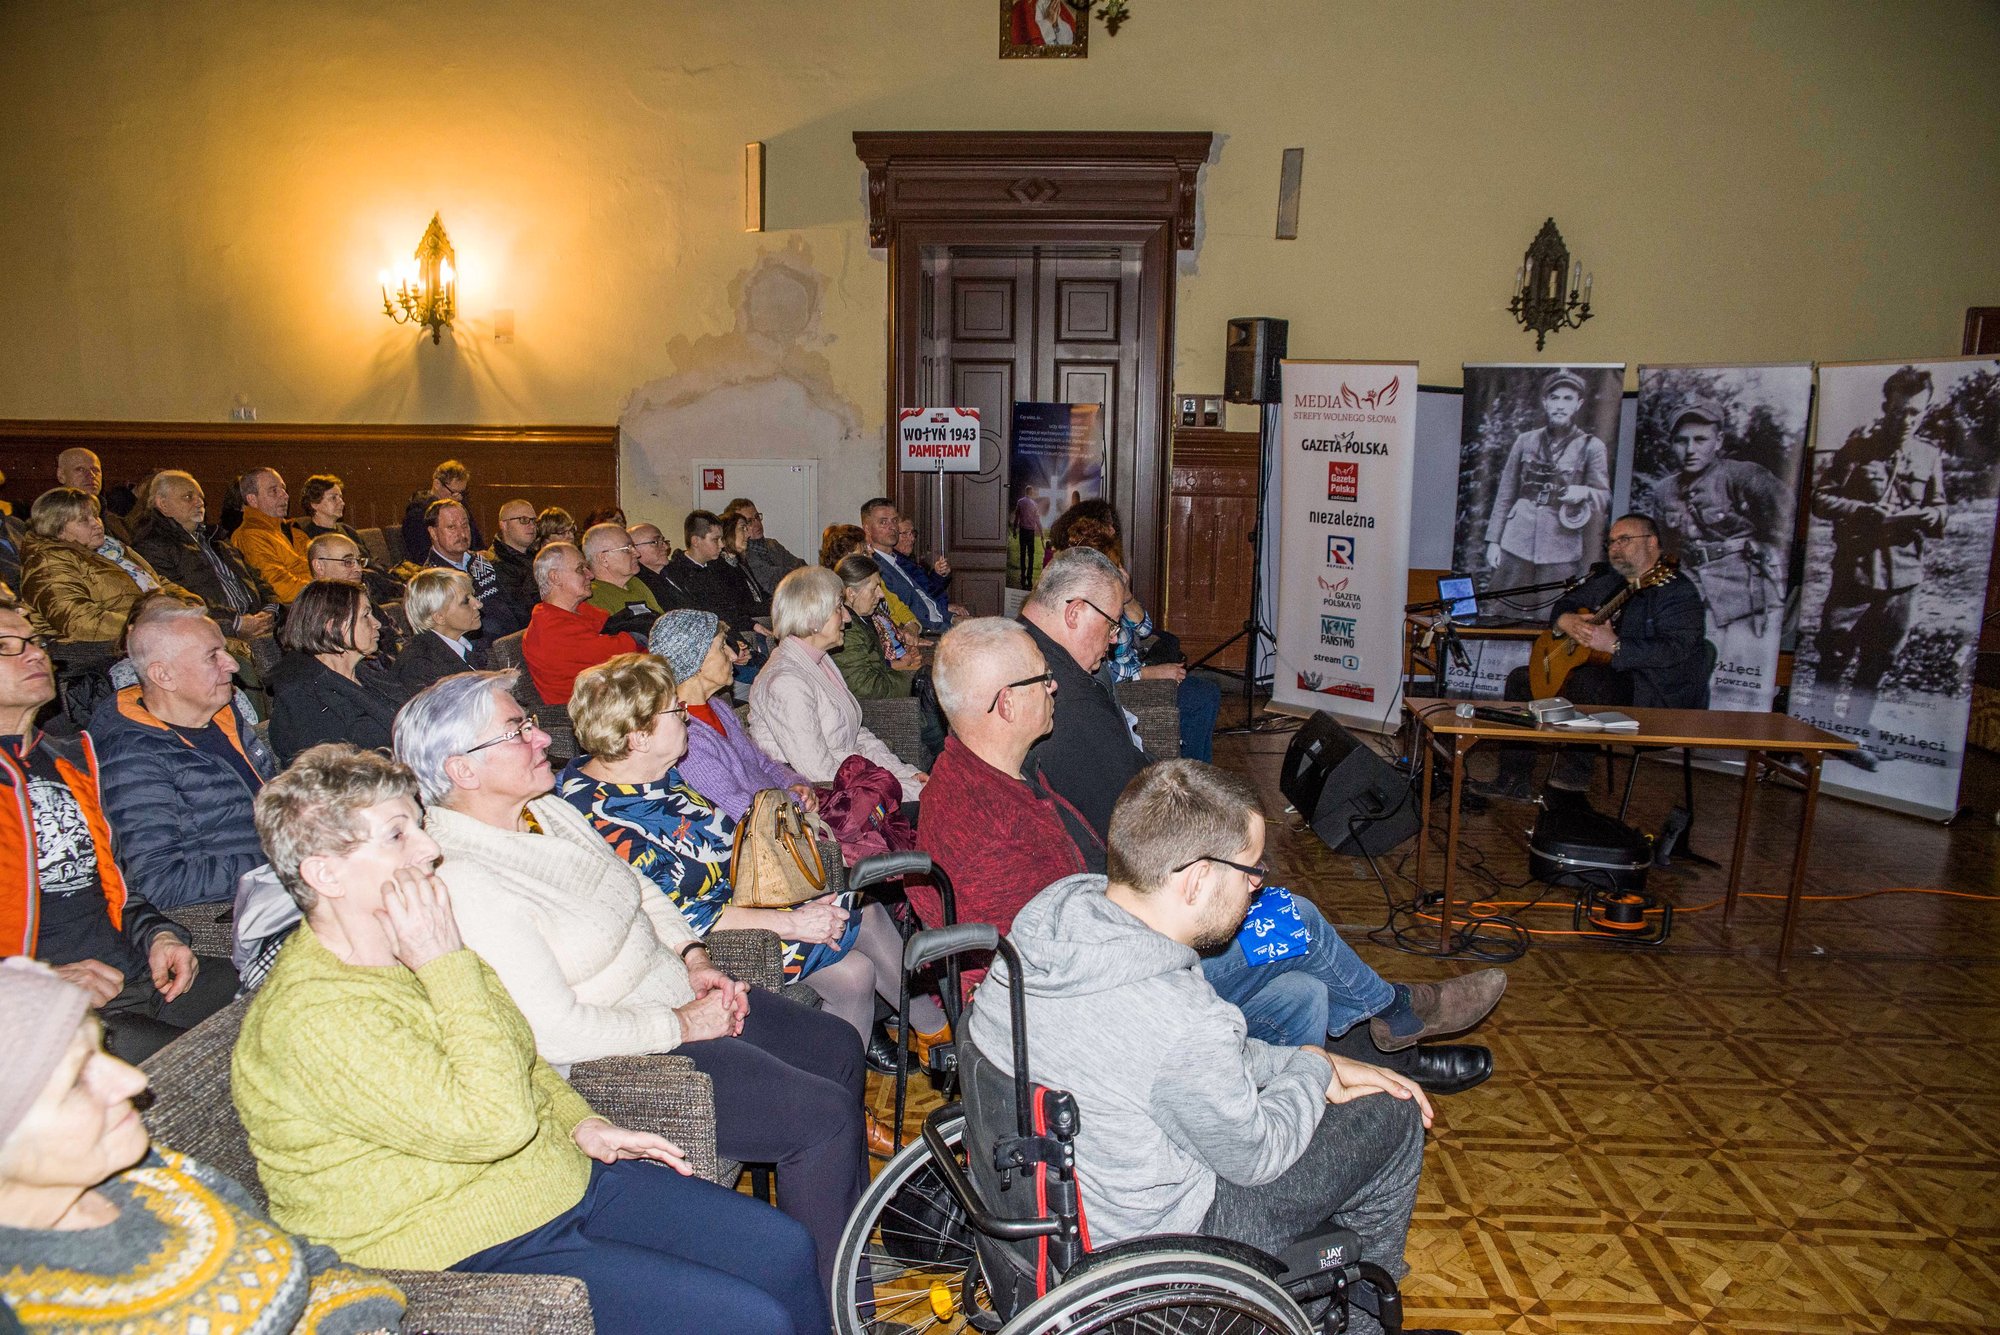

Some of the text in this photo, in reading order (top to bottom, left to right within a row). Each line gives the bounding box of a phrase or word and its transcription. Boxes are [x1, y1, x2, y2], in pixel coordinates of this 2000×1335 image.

[1294, 394, 1342, 409] MEDIA
[1293, 411, 1397, 424] STREFY WOLNEGO SŁOWA
[949, 428, 976, 441] 1943
[908, 444, 971, 459] PAMIĘTAMY
[1301, 439, 1388, 456] GAZETA POLSKA
[1331, 474, 1356, 484] Gazeta
[1330, 484, 1355, 494] Polska
[1323, 598, 1351, 609] POLSKA
[1335, 592, 1361, 602] GAZETA
[1314, 653, 1341, 664] stream
[1715, 677, 1762, 689] powraca
[1879, 730, 1947, 752] Wyklęci
[1894, 750, 1947, 767] powraca
[1326, 1245, 1344, 1260] JAY
[1320, 1257, 1342, 1270] Basic
